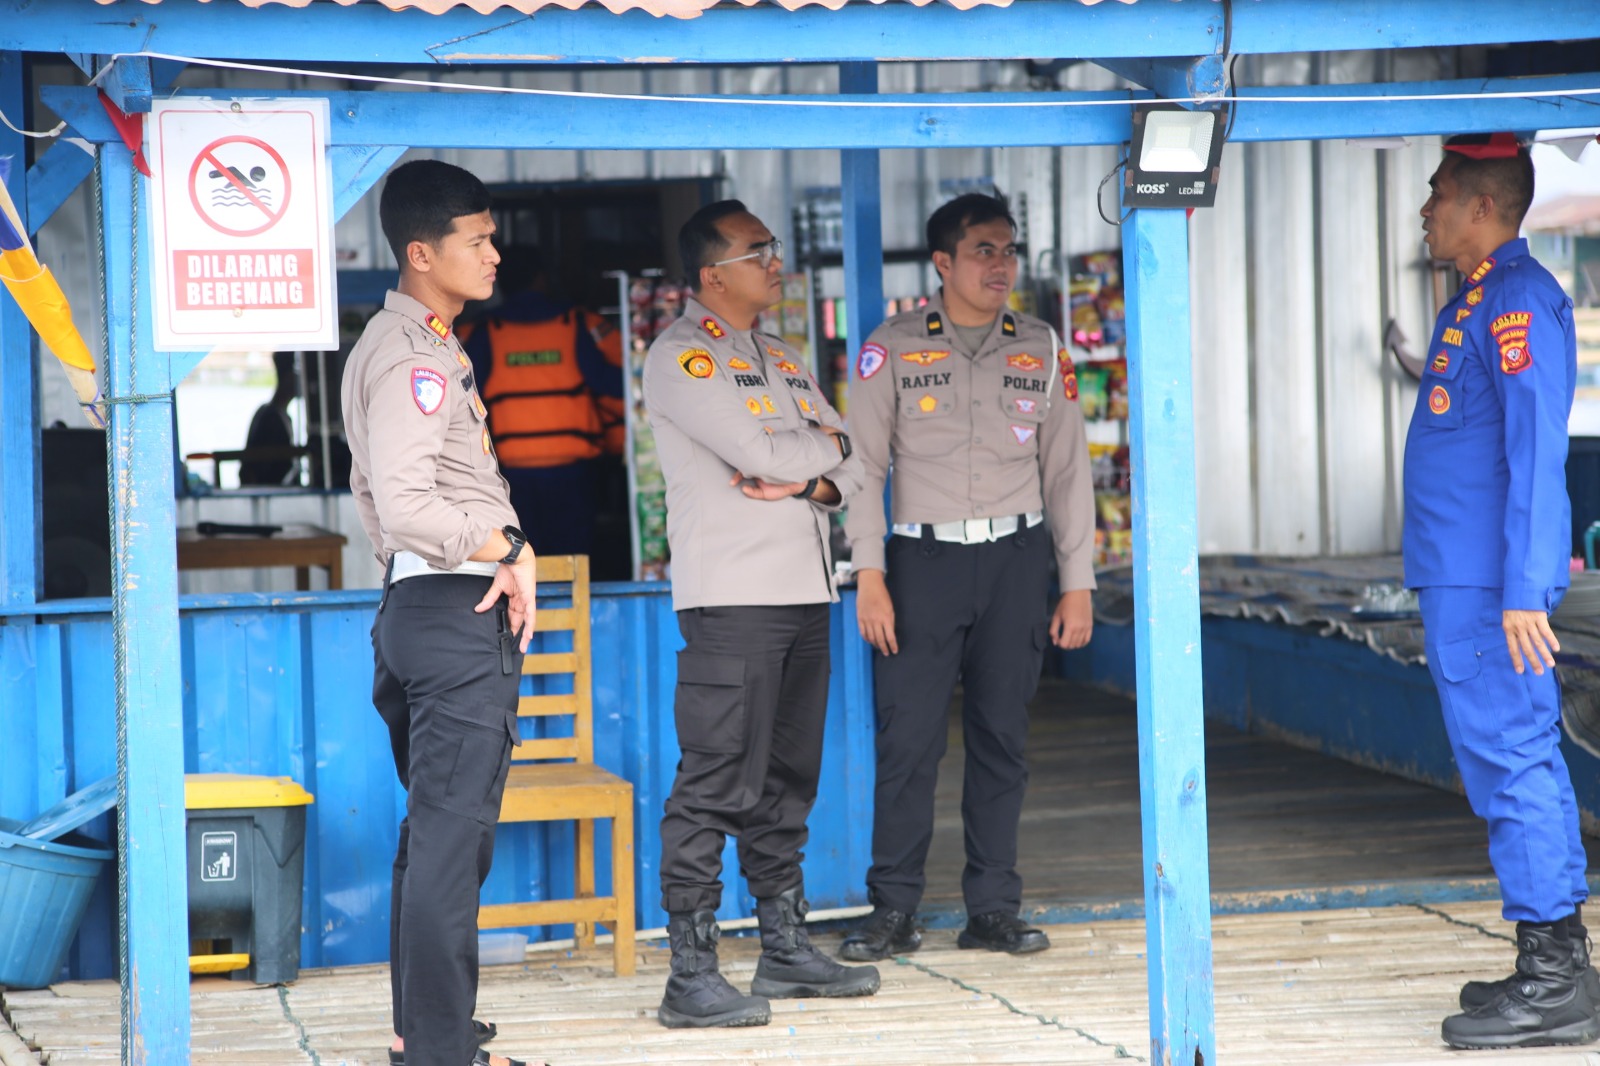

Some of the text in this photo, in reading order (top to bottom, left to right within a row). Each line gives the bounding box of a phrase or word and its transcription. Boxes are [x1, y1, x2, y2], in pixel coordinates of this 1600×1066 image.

[1136, 183, 1166, 194] KOSS
[187, 255, 298, 279] DILARANG
[186, 281, 303, 305] BERENANG
[1492, 313, 1529, 334] POLRES
[734, 374, 766, 387] FEBRI
[901, 372, 952, 389] RAFLY
[1003, 375, 1047, 393] POLRI
